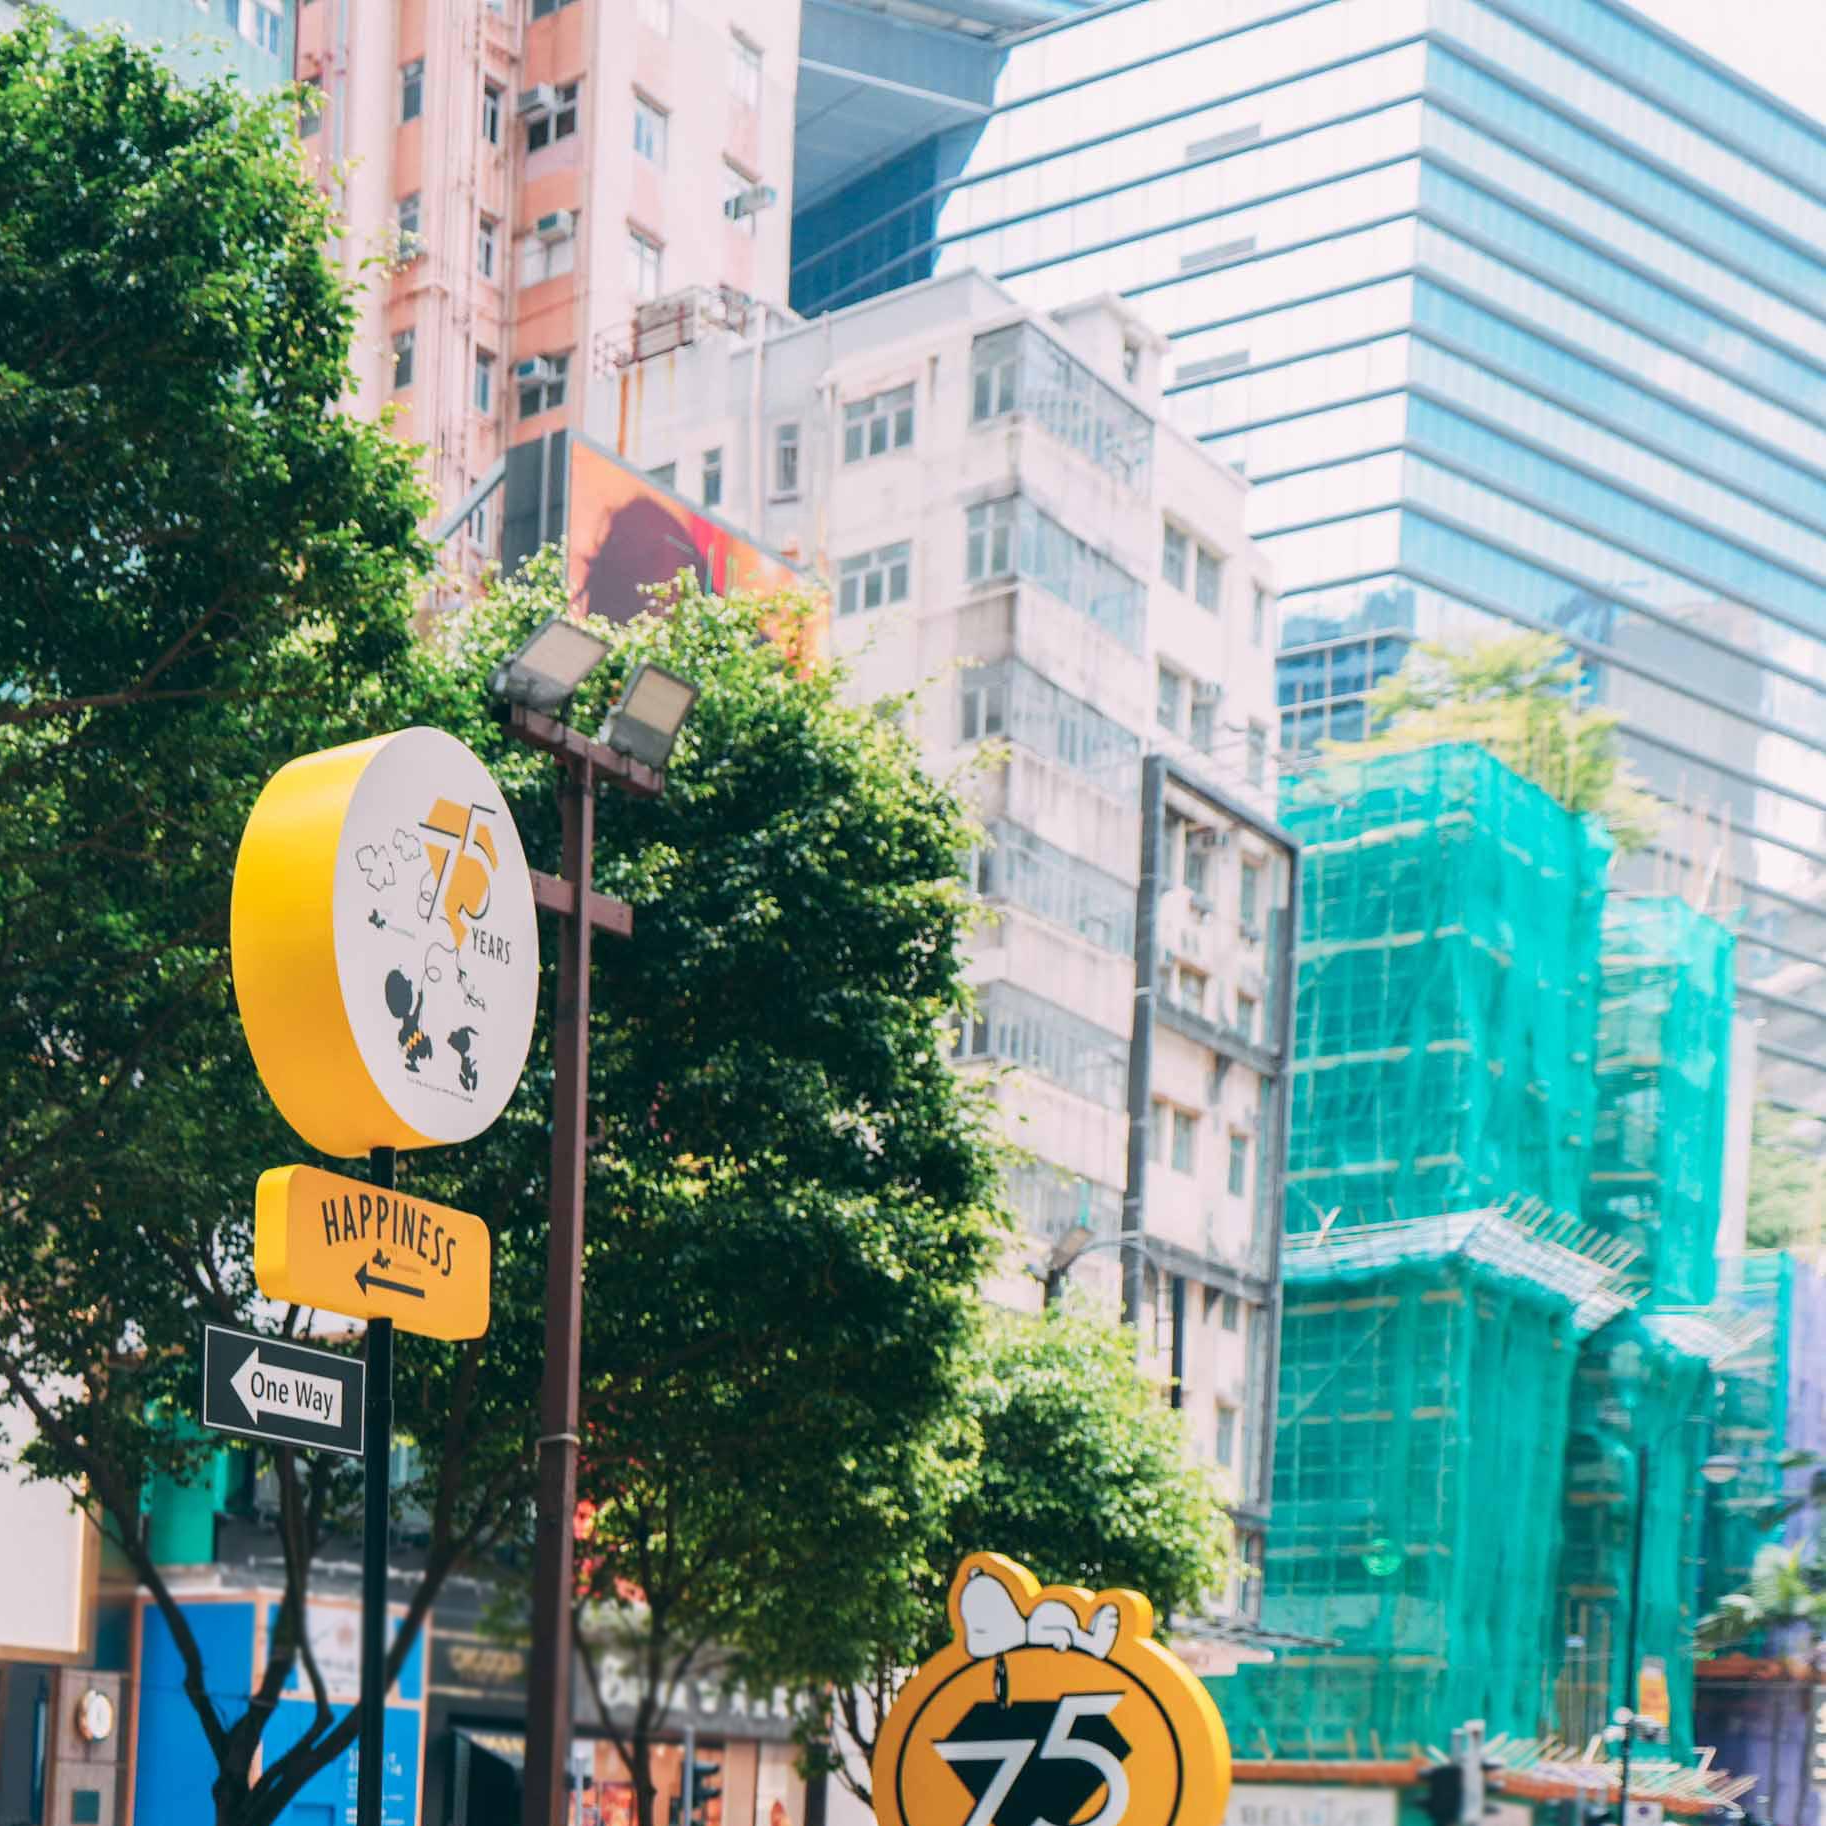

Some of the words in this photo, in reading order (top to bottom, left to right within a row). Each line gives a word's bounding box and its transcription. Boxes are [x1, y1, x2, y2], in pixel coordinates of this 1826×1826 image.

[417, 802, 497, 924] 75
[471, 926, 511, 966] YEARS
[320, 1193, 457, 1278] HAPPINESS
[250, 1370, 289, 1405] One
[295, 1378, 334, 1421] Way
